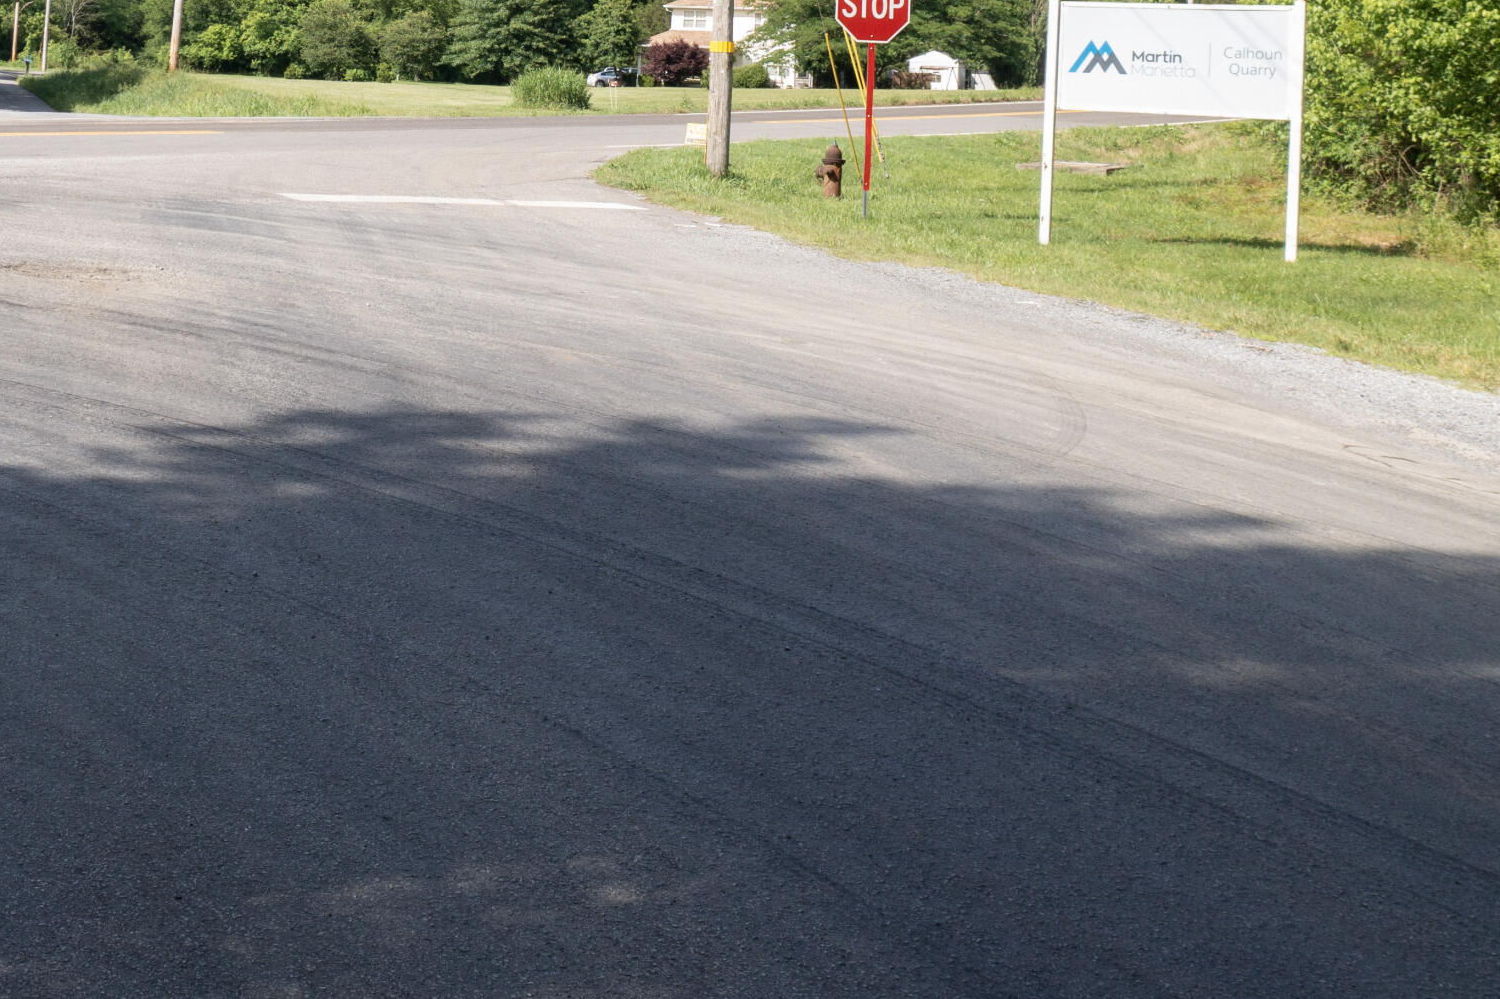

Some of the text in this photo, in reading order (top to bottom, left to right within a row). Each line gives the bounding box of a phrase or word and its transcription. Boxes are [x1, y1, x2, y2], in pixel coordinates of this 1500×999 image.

[1131, 50, 1182, 64] Martin
[1223, 46, 1283, 61] Calhoun
[1130, 64, 1196, 79] Marietta
[1228, 63, 1277, 80] Quarry
